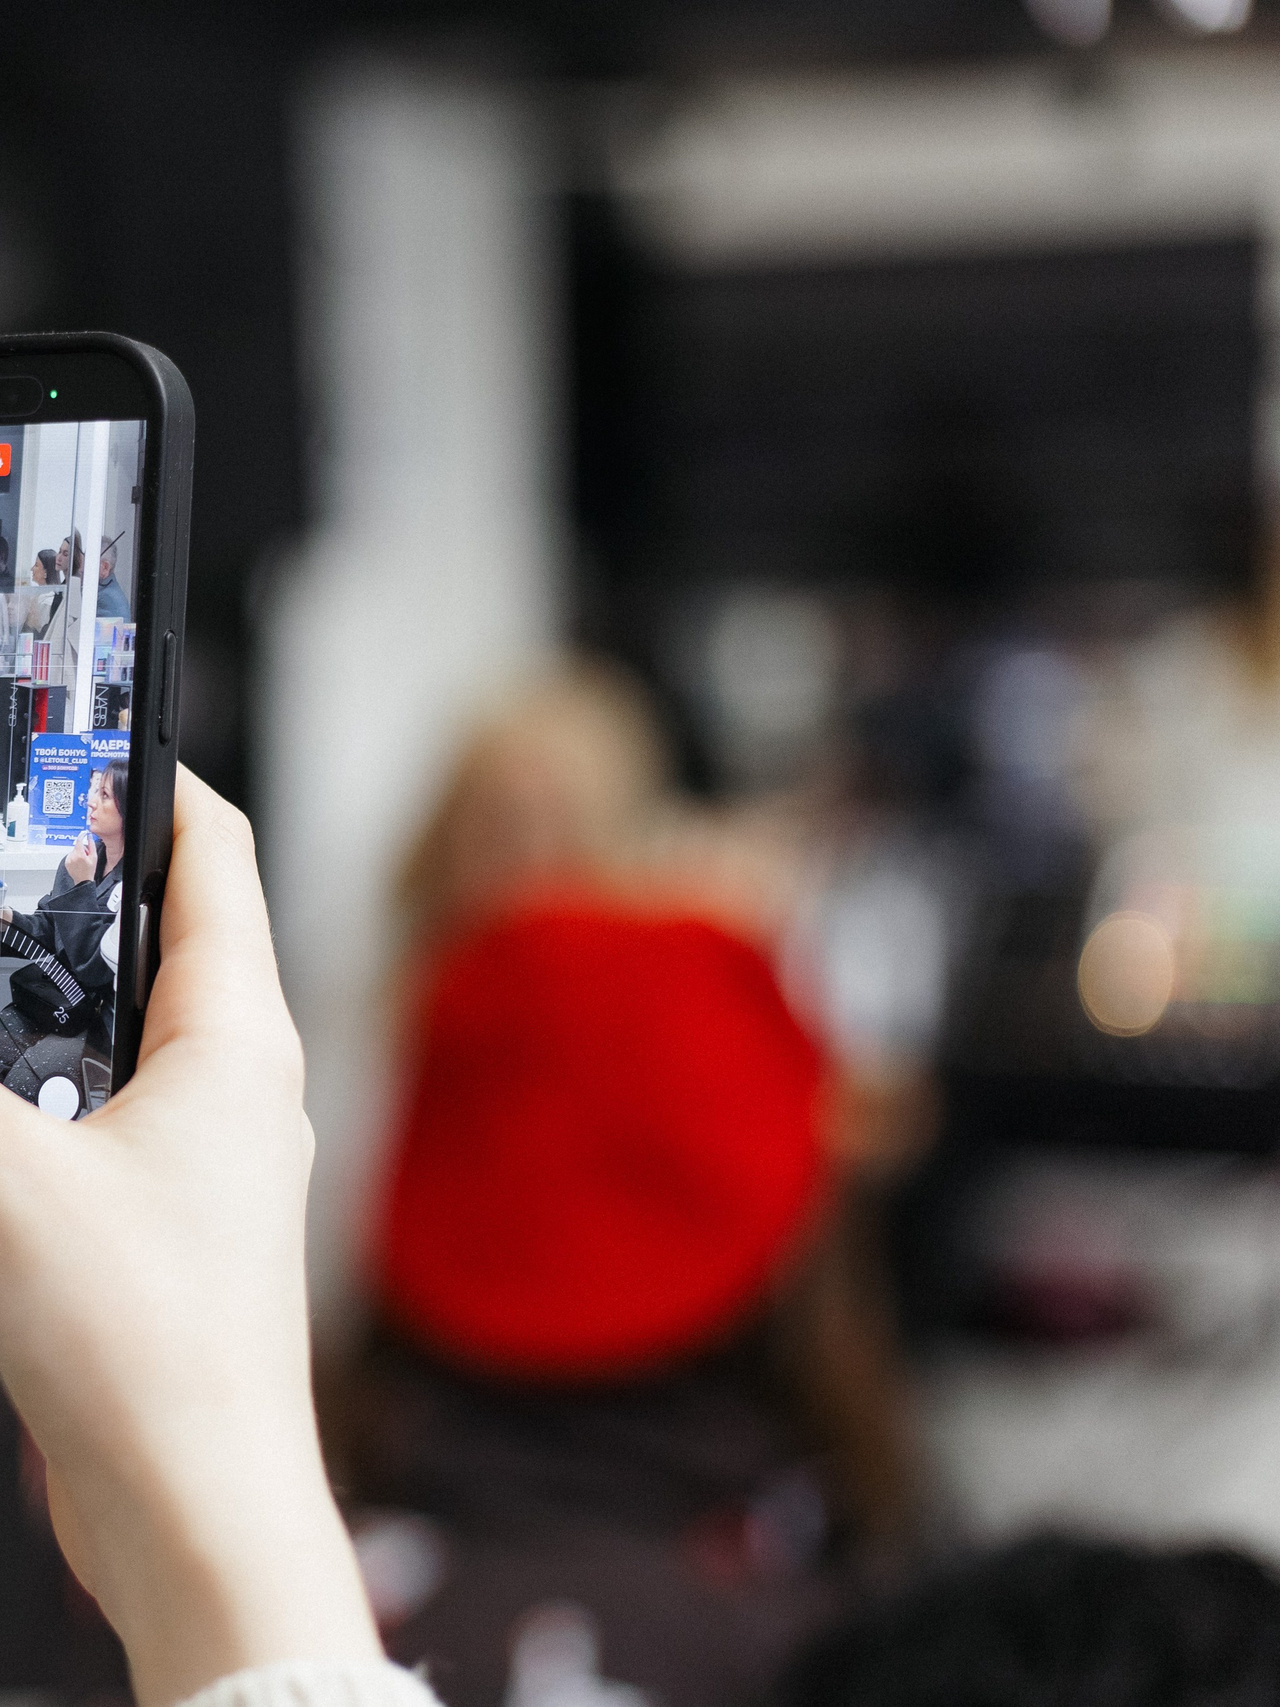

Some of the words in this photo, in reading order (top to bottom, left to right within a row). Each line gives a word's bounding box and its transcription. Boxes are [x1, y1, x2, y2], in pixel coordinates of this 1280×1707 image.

[8, 686, 18, 727] NARS
[94, 686, 110, 727] NARS
[34, 747, 57, 757] ТВОЙ
[58, 748, 87, 757] БОНУС
[40, 757, 88, 765] @LETOILE_CLUB
[52, 1006, 70, 1024] 25
